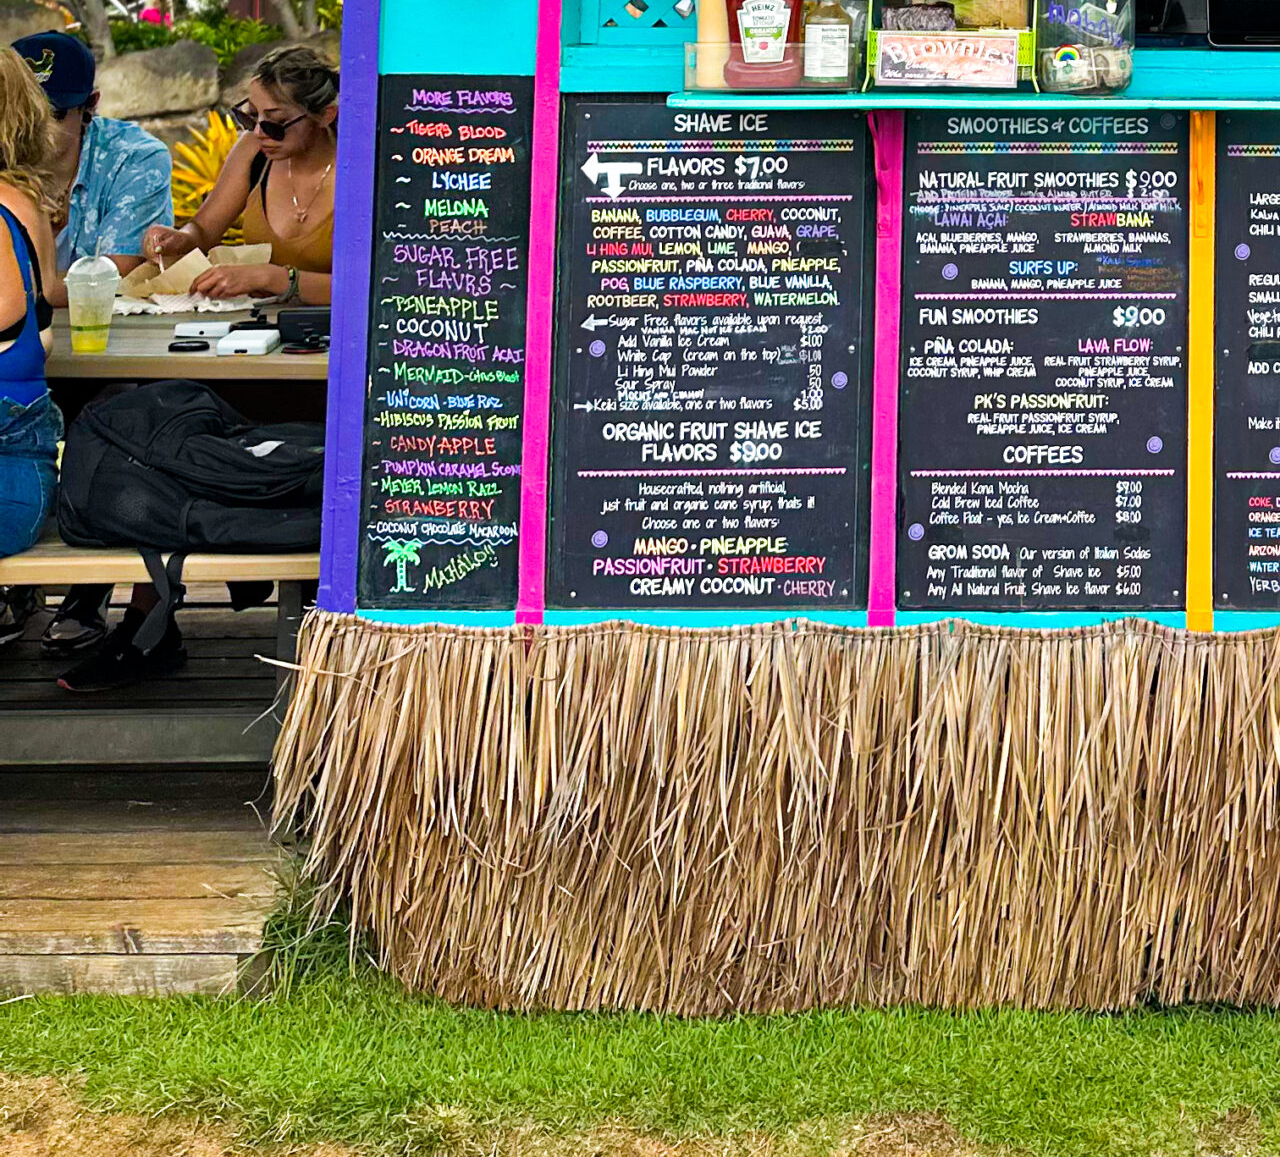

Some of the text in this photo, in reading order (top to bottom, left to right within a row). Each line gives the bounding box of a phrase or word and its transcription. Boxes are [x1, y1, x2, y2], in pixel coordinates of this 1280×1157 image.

[886, 41, 1012, 66] Brownies
[412, 89, 513, 106] MORE FLAVORS
[406, 119, 506, 140] TIGERS BLOOD
[674, 113, 768, 133] SHAVE ICE
[948, 117, 1049, 135] SMOOTHIES
[1069, 118, 1148, 134] COFFEES
[411, 147, 515, 167] ORANGE DREAM
[647, 155, 788, 179] FLAVORS $7.00
[432, 171, 491, 190] LYCHEE
[628, 179, 658, 191] Choose
[662, 181, 678, 191] one,
[681, 181, 695, 190] two
[698, 181, 708, 189] or
[712, 179, 734, 190] three
[919, 170, 984, 189] NATURAL
[987, 171, 1029, 188] FRUIT
[1034, 171, 1119, 188] SMOOTHIES
[425, 198, 489, 217] MELONA
[592, 207, 842, 224] BANANA, BUBBLEGUM, CHERRY, COCONUT,
[429, 219, 487, 235] PEACH
[593, 225, 839, 241] COFFEE, COTTON CANDY, GUAVA, GRAPE,
[394, 244, 519, 274] SUGAR FREE
[592, 257, 841, 275] PASSIONFRUIT, PIÑA COLADA, PINEAPPLE,
[1009, 260, 1078, 275] SURFS UP:
[392, 295, 499, 321] PINEAPPLE
[396, 318, 488, 343] COCONUT
[393, 339, 450, 358] DRAGON
[1011, 392, 1109, 409] PASSIONFRUIT:
[603, 421, 822, 440] ORGANIC FRUIT SHAVE ICE
[390, 436, 496, 457] CANDY APPLE
[1003, 445, 1084, 464] COFFEES
[384, 499, 494, 520] STRAWBERRY
[1248, 497, 1273, 508] COKE,
